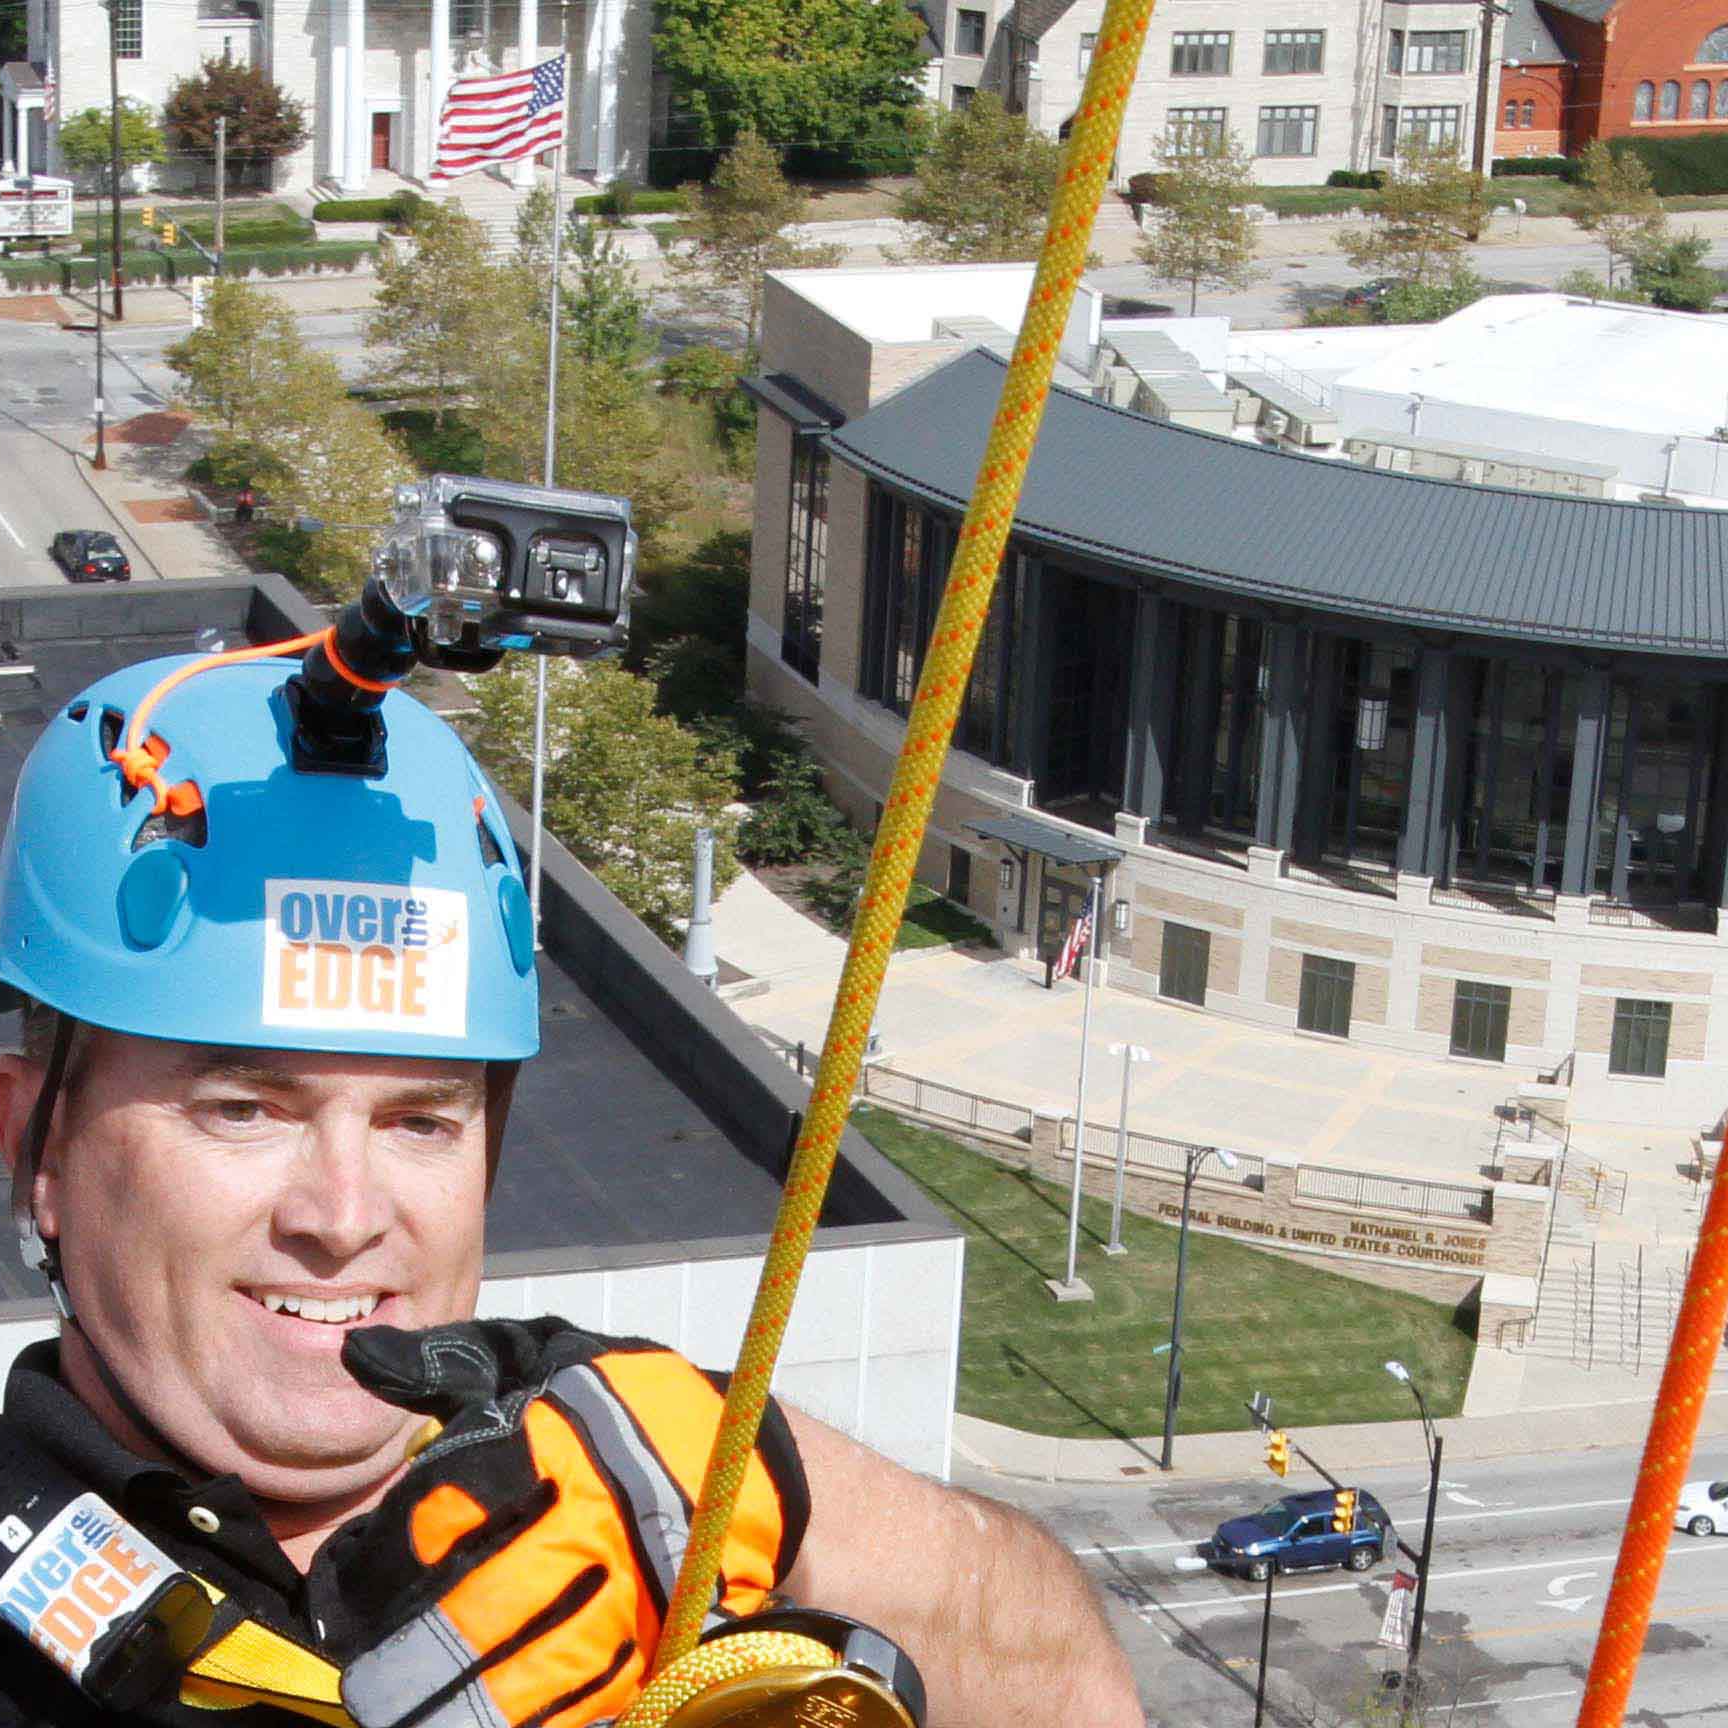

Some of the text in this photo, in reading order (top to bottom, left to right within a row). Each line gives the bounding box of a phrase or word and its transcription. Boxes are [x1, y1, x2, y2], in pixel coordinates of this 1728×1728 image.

[281, 892, 428, 947] over the
[278, 942, 428, 1017] EDGE
[1158, 1203, 1486, 1266] FEDRAL BUILDING & UNITED STATES COURTHOUSE
[1350, 1221, 1419, 1243] NATHANIEL
[1443, 1235, 1487, 1249] JONES
